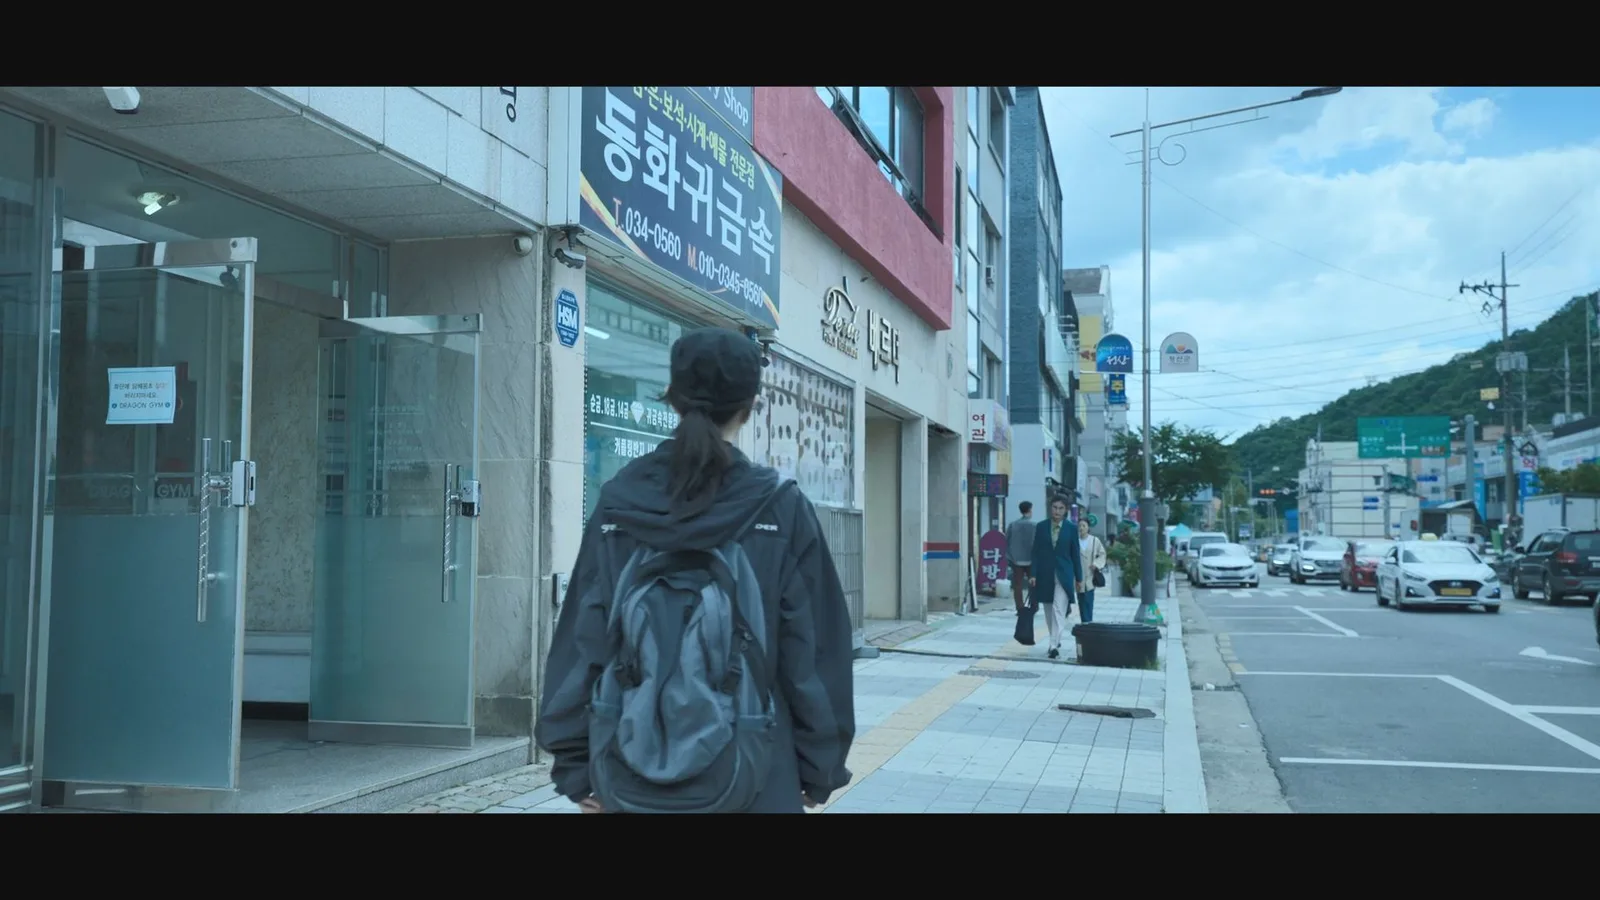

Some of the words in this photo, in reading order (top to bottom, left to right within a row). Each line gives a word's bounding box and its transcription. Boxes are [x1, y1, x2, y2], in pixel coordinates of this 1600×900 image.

[724, 86, 749, 126] Shop
[596, 86, 775, 275] 동화귀금속
[730, 147, 755, 191] 전문점
[558, 304, 578, 330] HSM
[972, 413, 987, 441] 여관
[157, 483, 192, 498] GYM
[983, 547, 1002, 580] 다방
